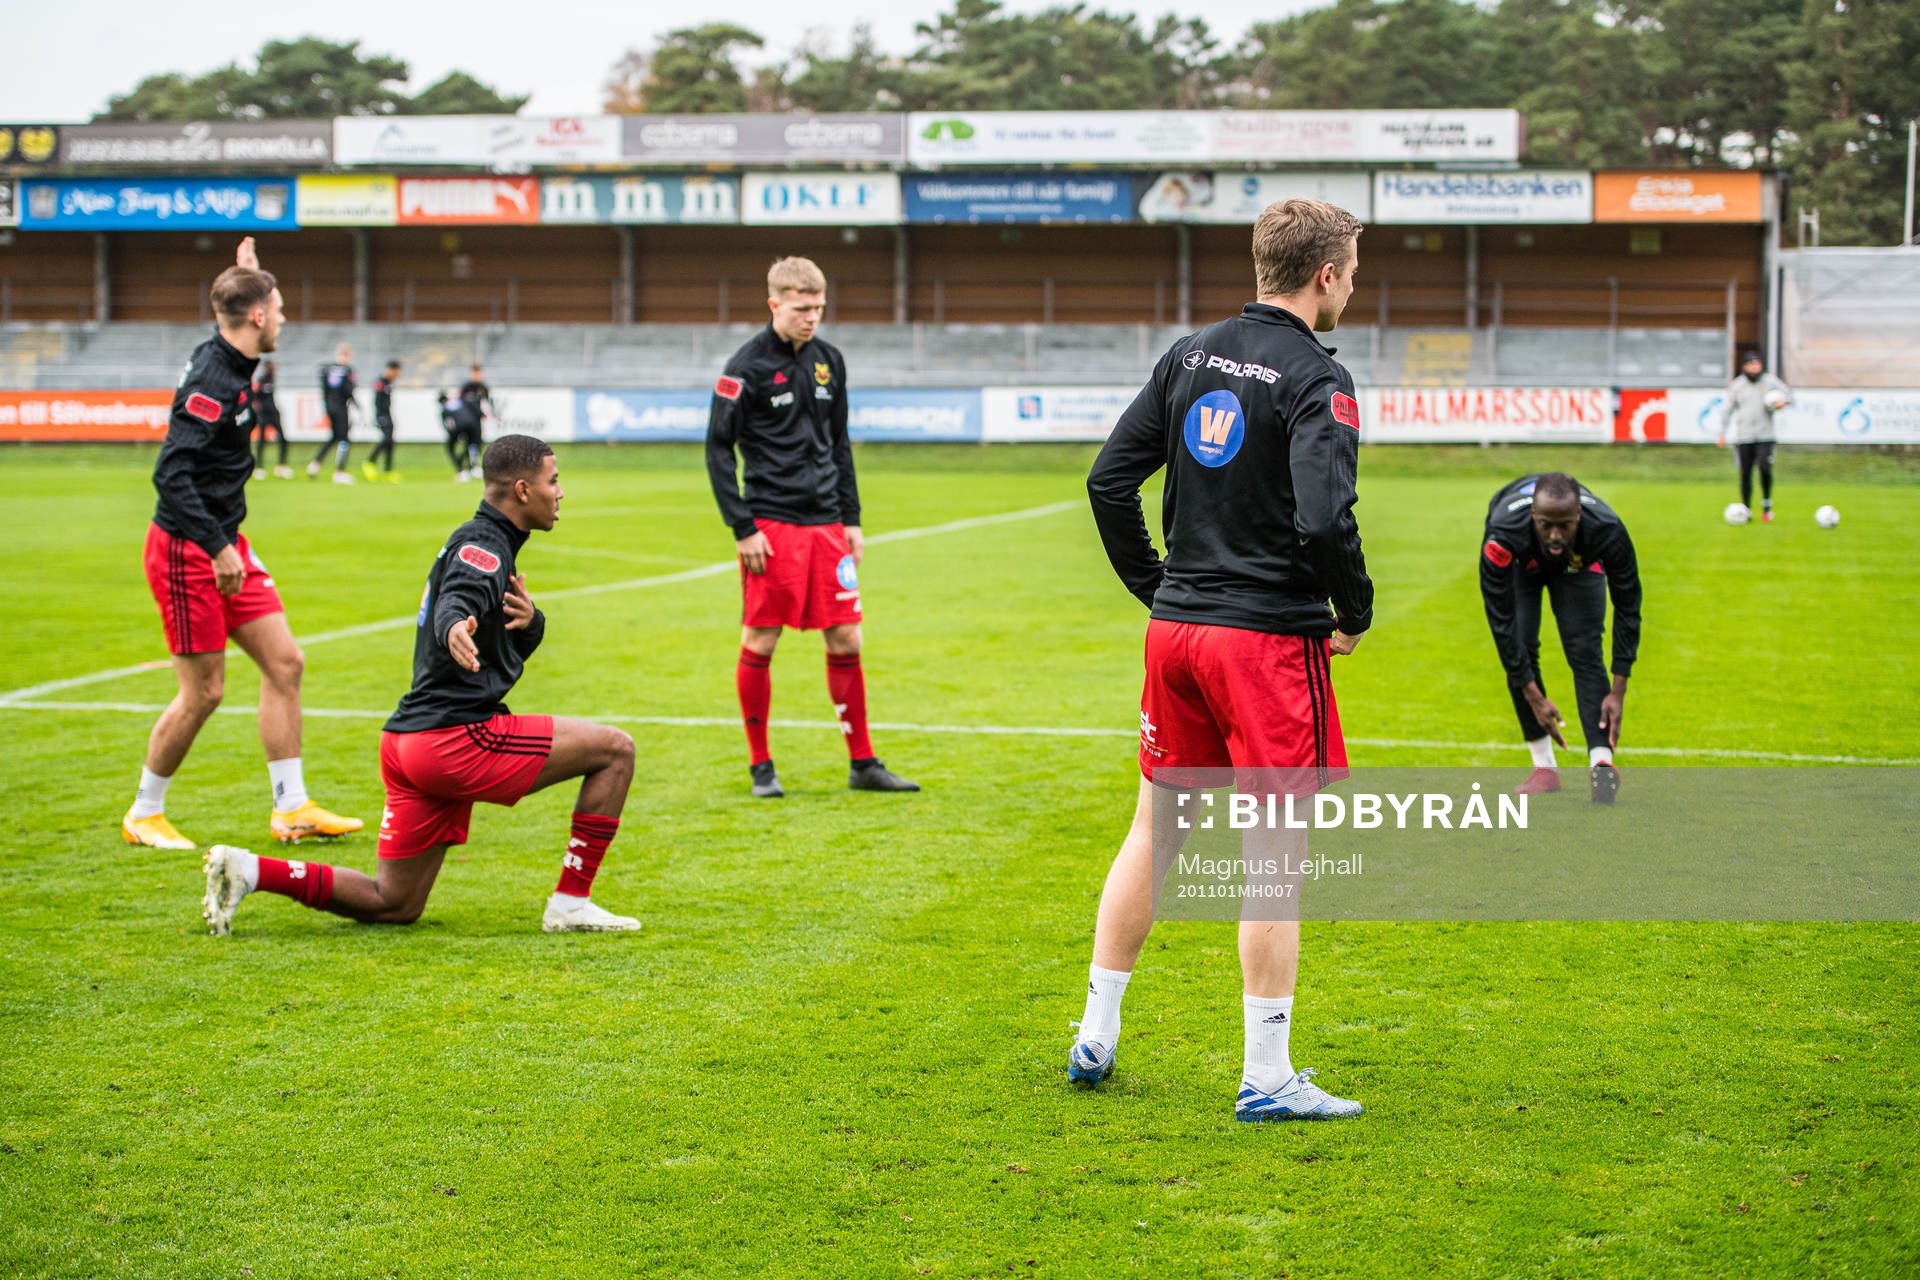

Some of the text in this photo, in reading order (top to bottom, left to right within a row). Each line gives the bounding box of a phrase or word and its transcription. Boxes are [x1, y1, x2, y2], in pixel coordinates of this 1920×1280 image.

[1382, 173, 1583, 198] Handelsbanken
[1207, 355, 1281, 384] POLARIS
[1200, 406, 1237, 446] W
